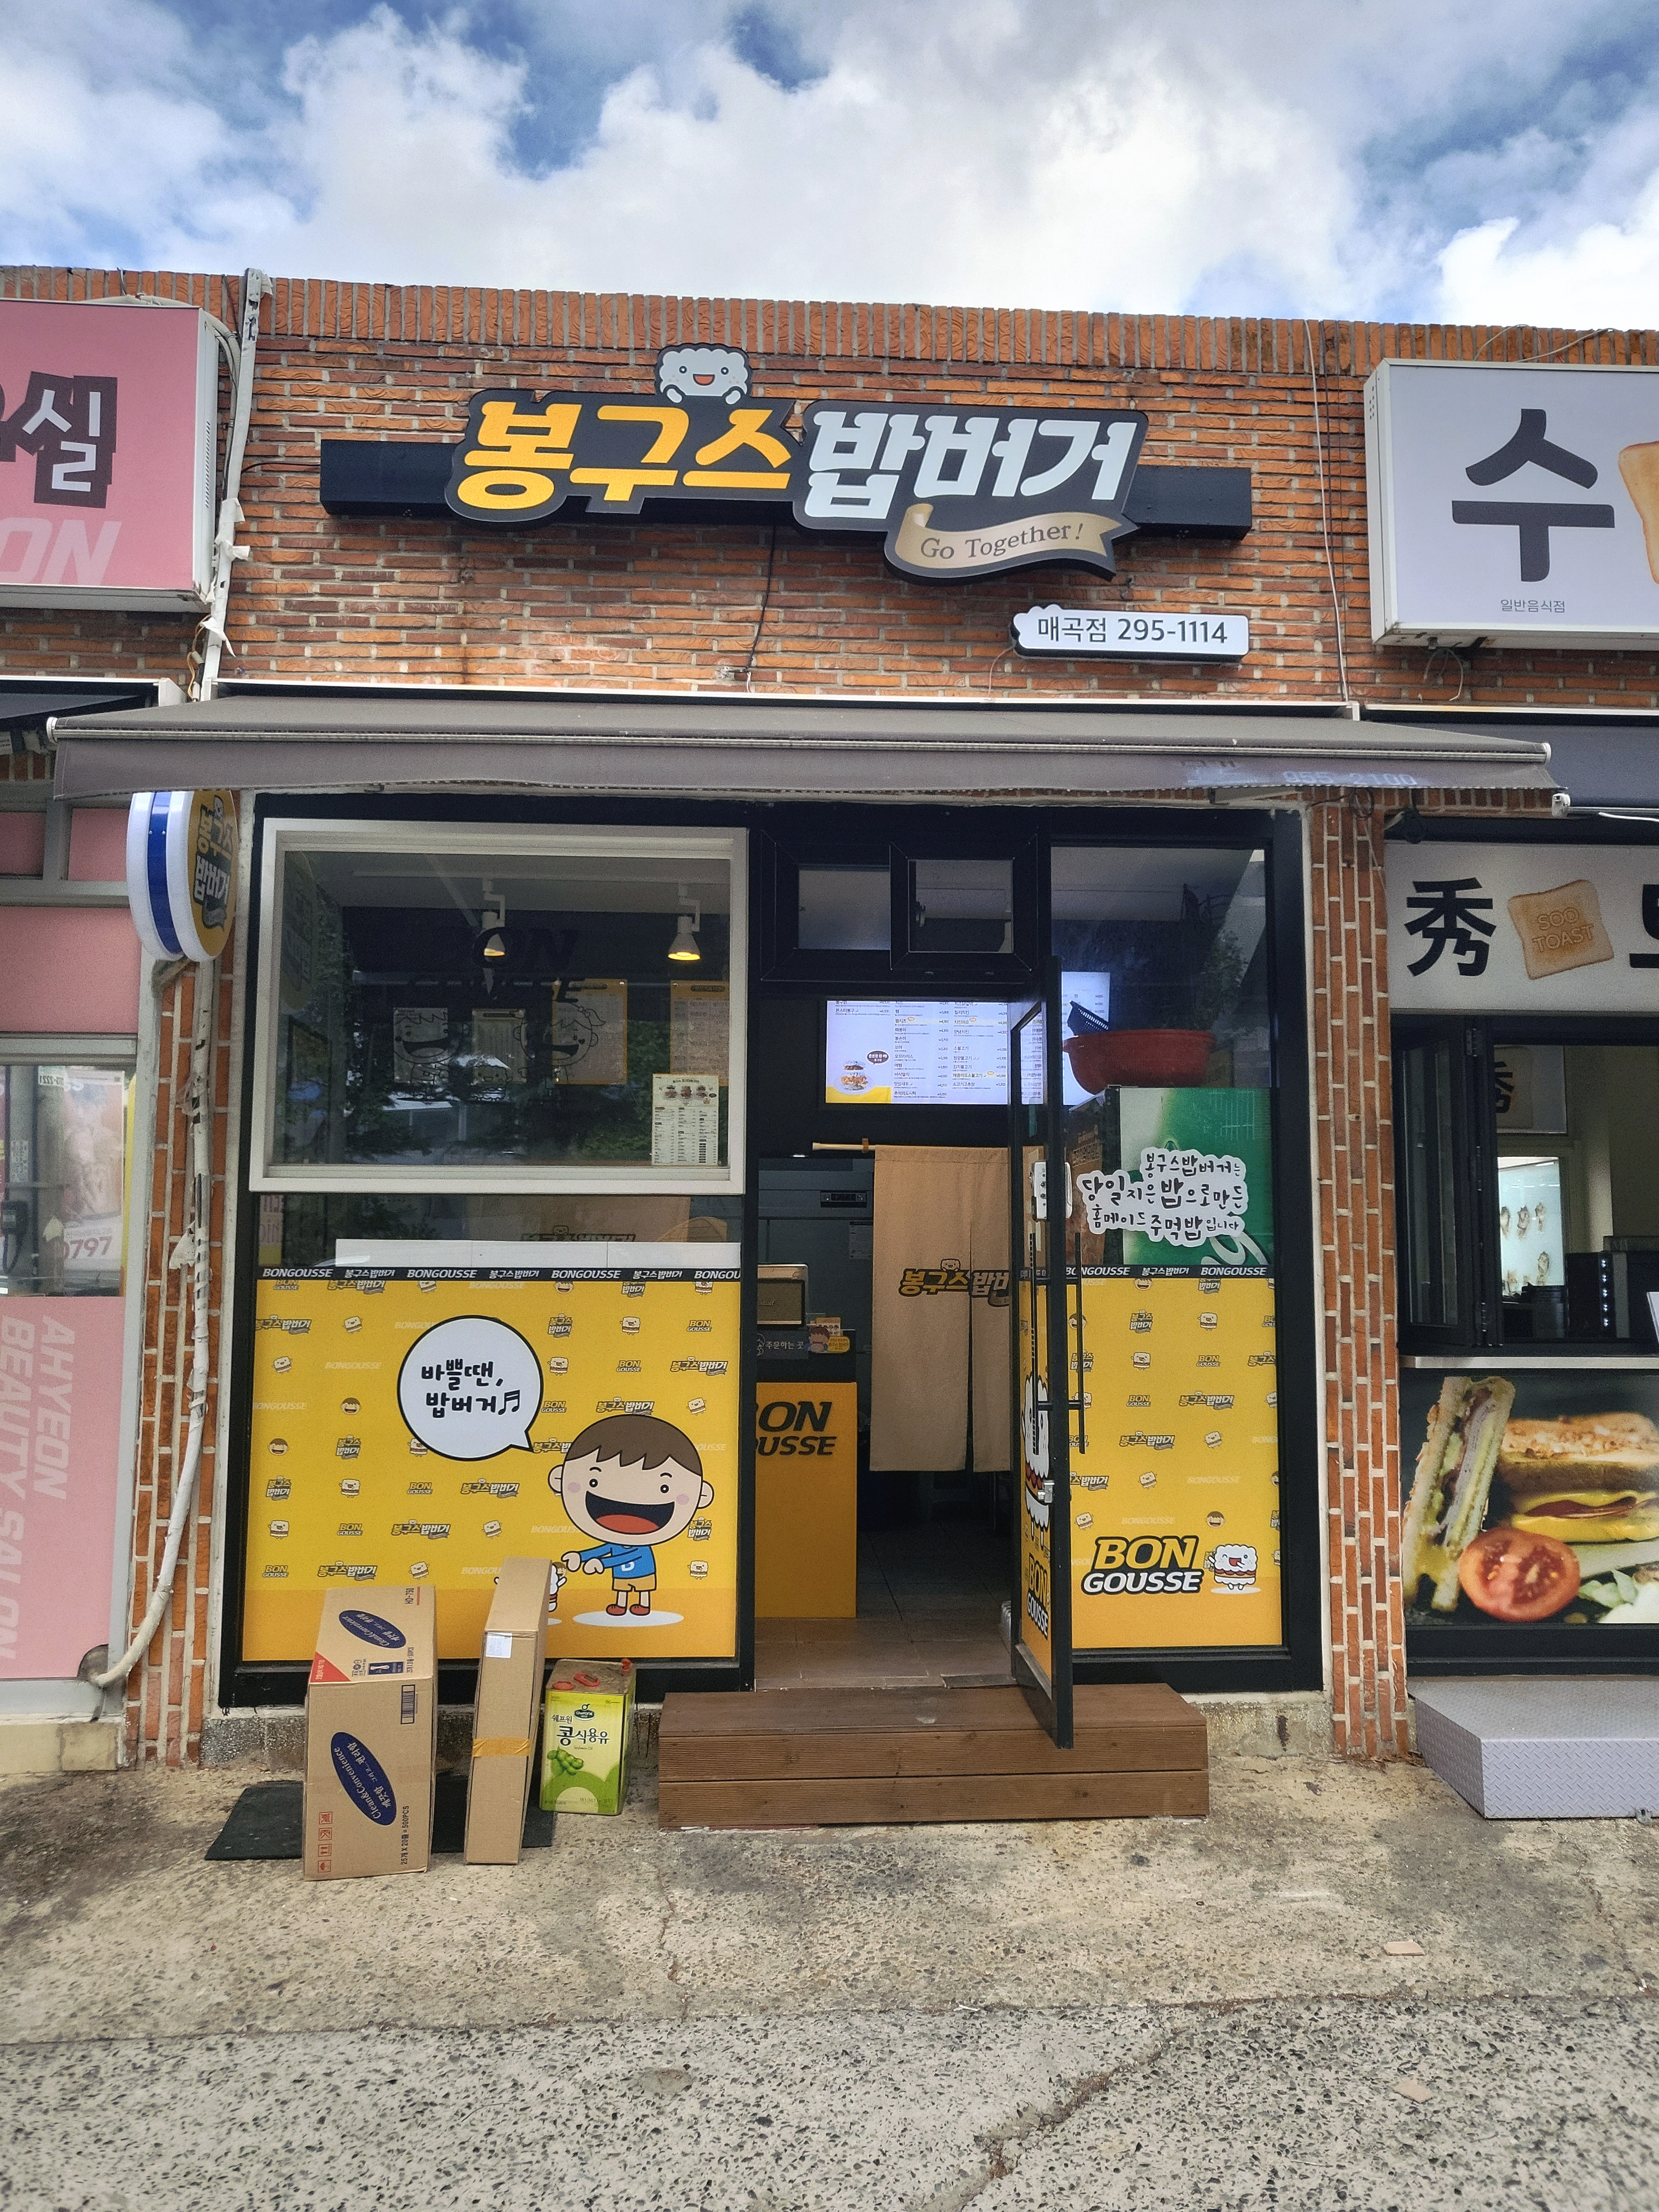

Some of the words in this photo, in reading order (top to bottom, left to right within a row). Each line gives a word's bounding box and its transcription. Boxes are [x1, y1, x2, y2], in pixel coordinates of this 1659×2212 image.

[1452, 409, 1615, 582] 수
[921, 538, 954, 559] Go
[1500, 598, 1566, 613] 일반음식점
[1037, 616, 1107, 644] 매곡점
[1118, 618, 1227, 644] 295-1114
[1404, 878, 1496, 976] 秀
[1537, 907, 1579, 931] SOO
[1532, 924, 1594, 953] TOAST
[1145, 1152, 1240, 1178] 봉구스밥버거는
[263, 1268, 333, 1277] BONGOUSSE
[345, 1269, 395, 1278] 봉구스밥버거
[407, 1270, 478, 1279] BONGOUSSE
[489, 1270, 540, 1279] 봉구스밥버거
[551, 1270, 622, 1279] BONGOUSSE
[633, 1270, 682, 1279] 봉구스밥버거
[694, 1271, 741, 1279] BONGOU
[1141, 1267, 1190, 1276] 봉구스밥버거
[1201, 1267, 1267, 1276] BONGOUSSE
[765, 1341, 795, 1350] 주문하는
[796, 1341, 804, 1350] 곳
[33, 1316, 75, 1499] AHYEON
[426, 1392, 497, 1418] 밥버거
[758, 1401, 832, 1432] ON
[758, 1436, 837, 1455] USSE
[1093, 1537, 1197, 1571] BON
[1029, 1553, 1048, 1608] BON
[1083, 1571, 1202, 1593] GOUSSE
[405, 1588, 414, 1604] HD-750
[1027, 1592, 1048, 1637] GOUSSE
[552, 1714, 572, 1724] 쉐프원
[556, 1725, 611, 1746] 콩식용유
[334, 1746, 382, 1820] Clean&Convenience
